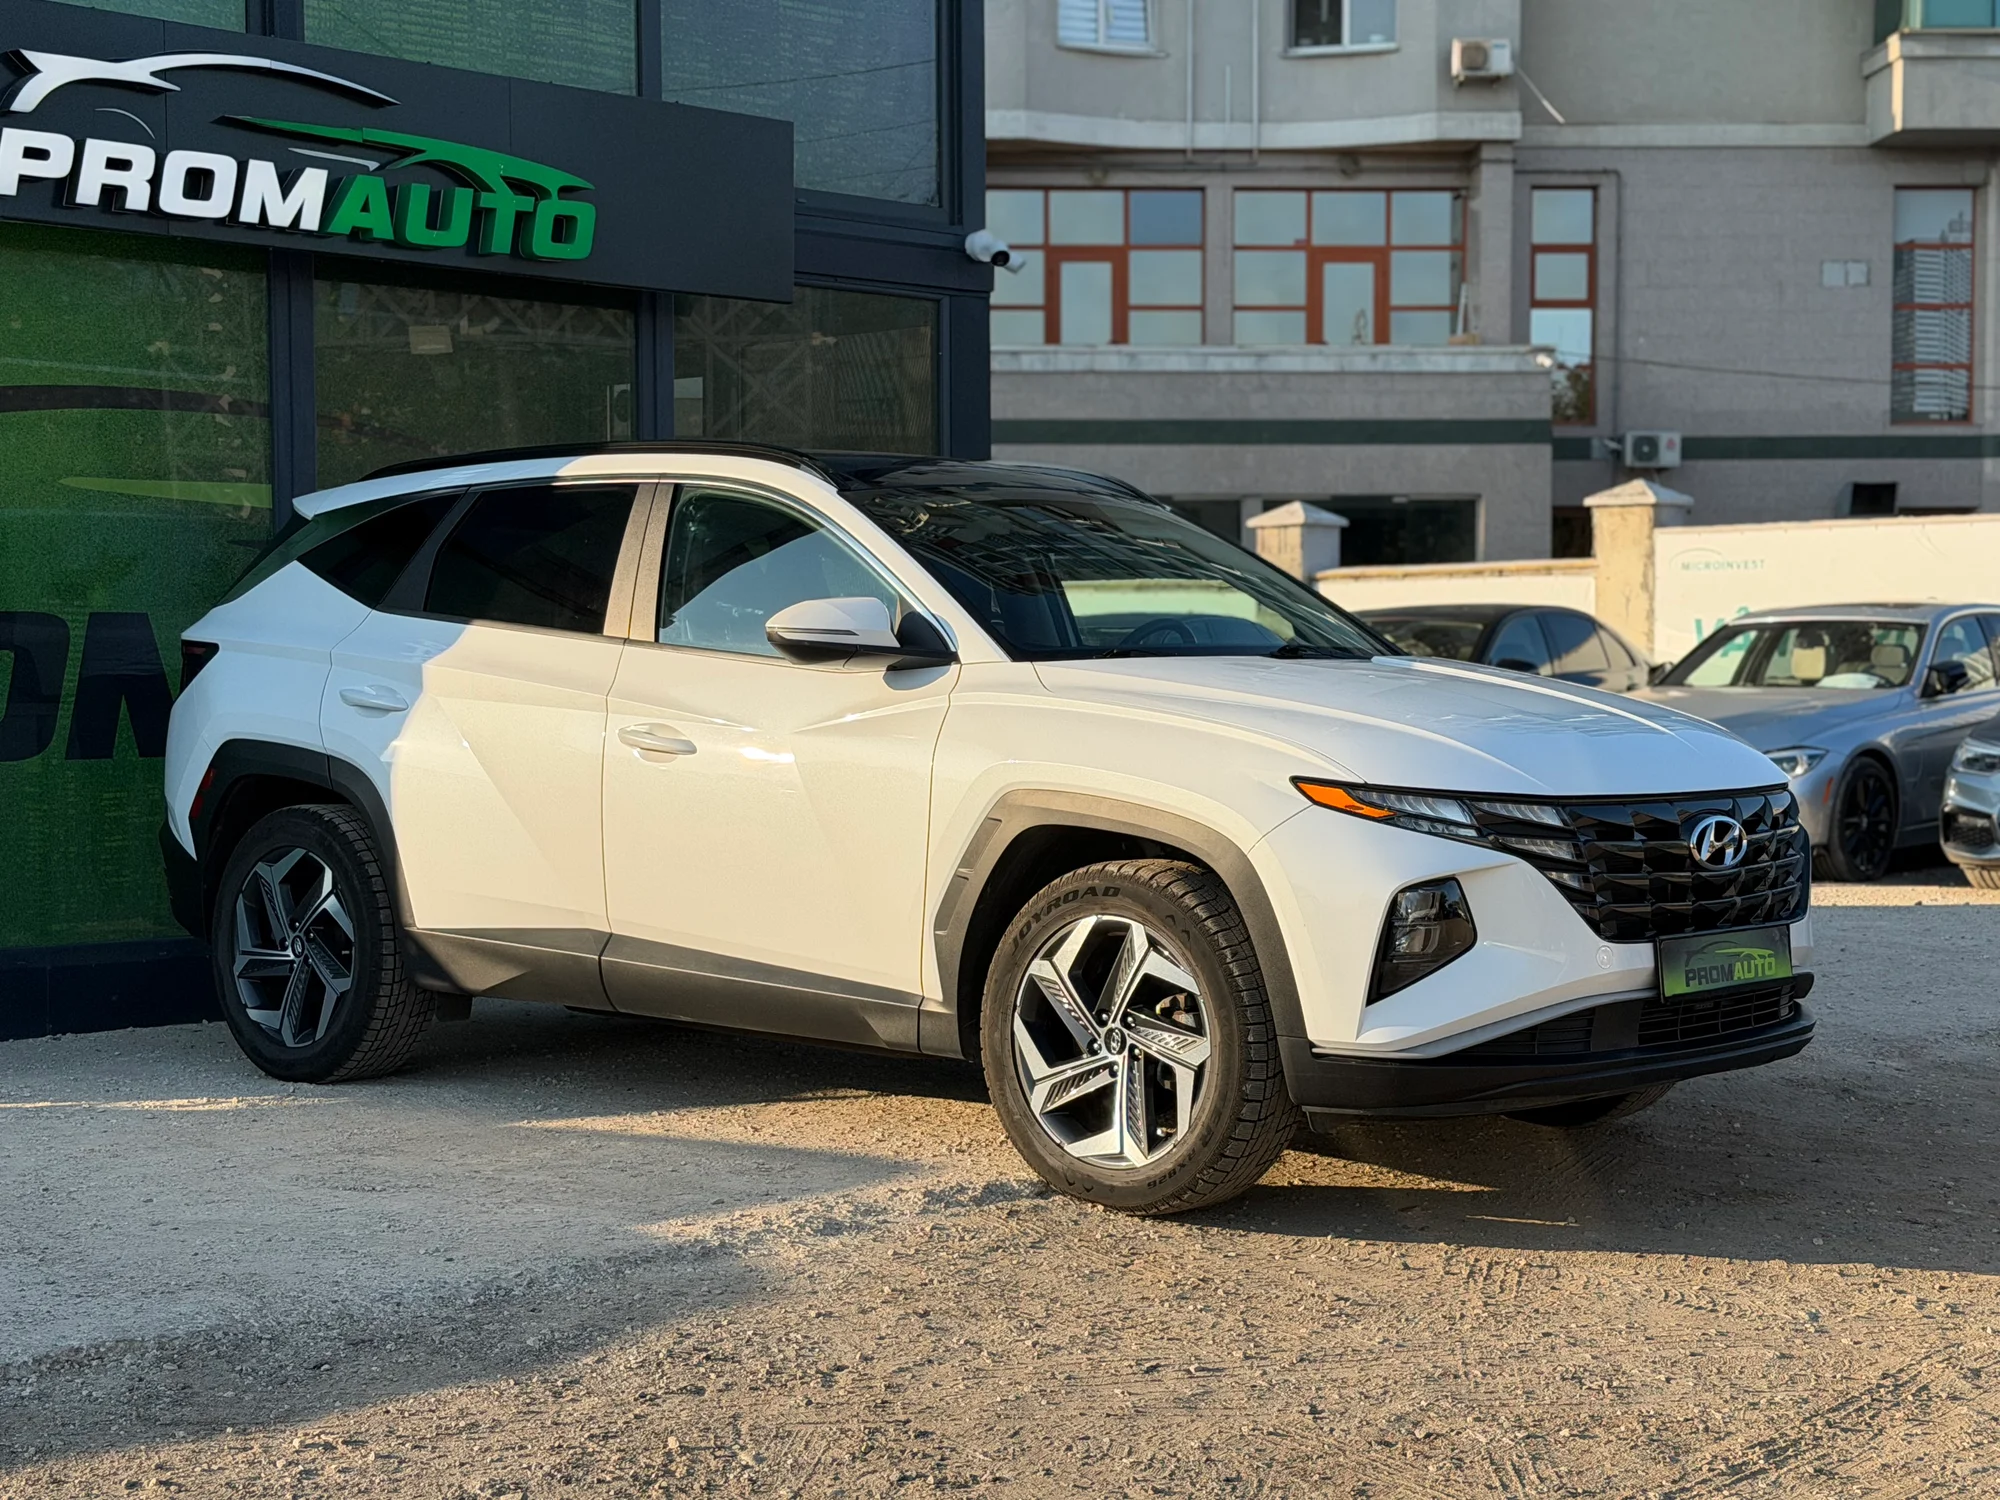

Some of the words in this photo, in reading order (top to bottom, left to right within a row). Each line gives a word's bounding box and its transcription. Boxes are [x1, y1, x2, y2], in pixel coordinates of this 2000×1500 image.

[0, 127, 597, 260] PROMAUTO
[1681, 558, 1765, 571] MICROINVEST
[1012, 886, 1121, 956] JOYROAD
[1685, 957, 1776, 987] PROMAUTO
